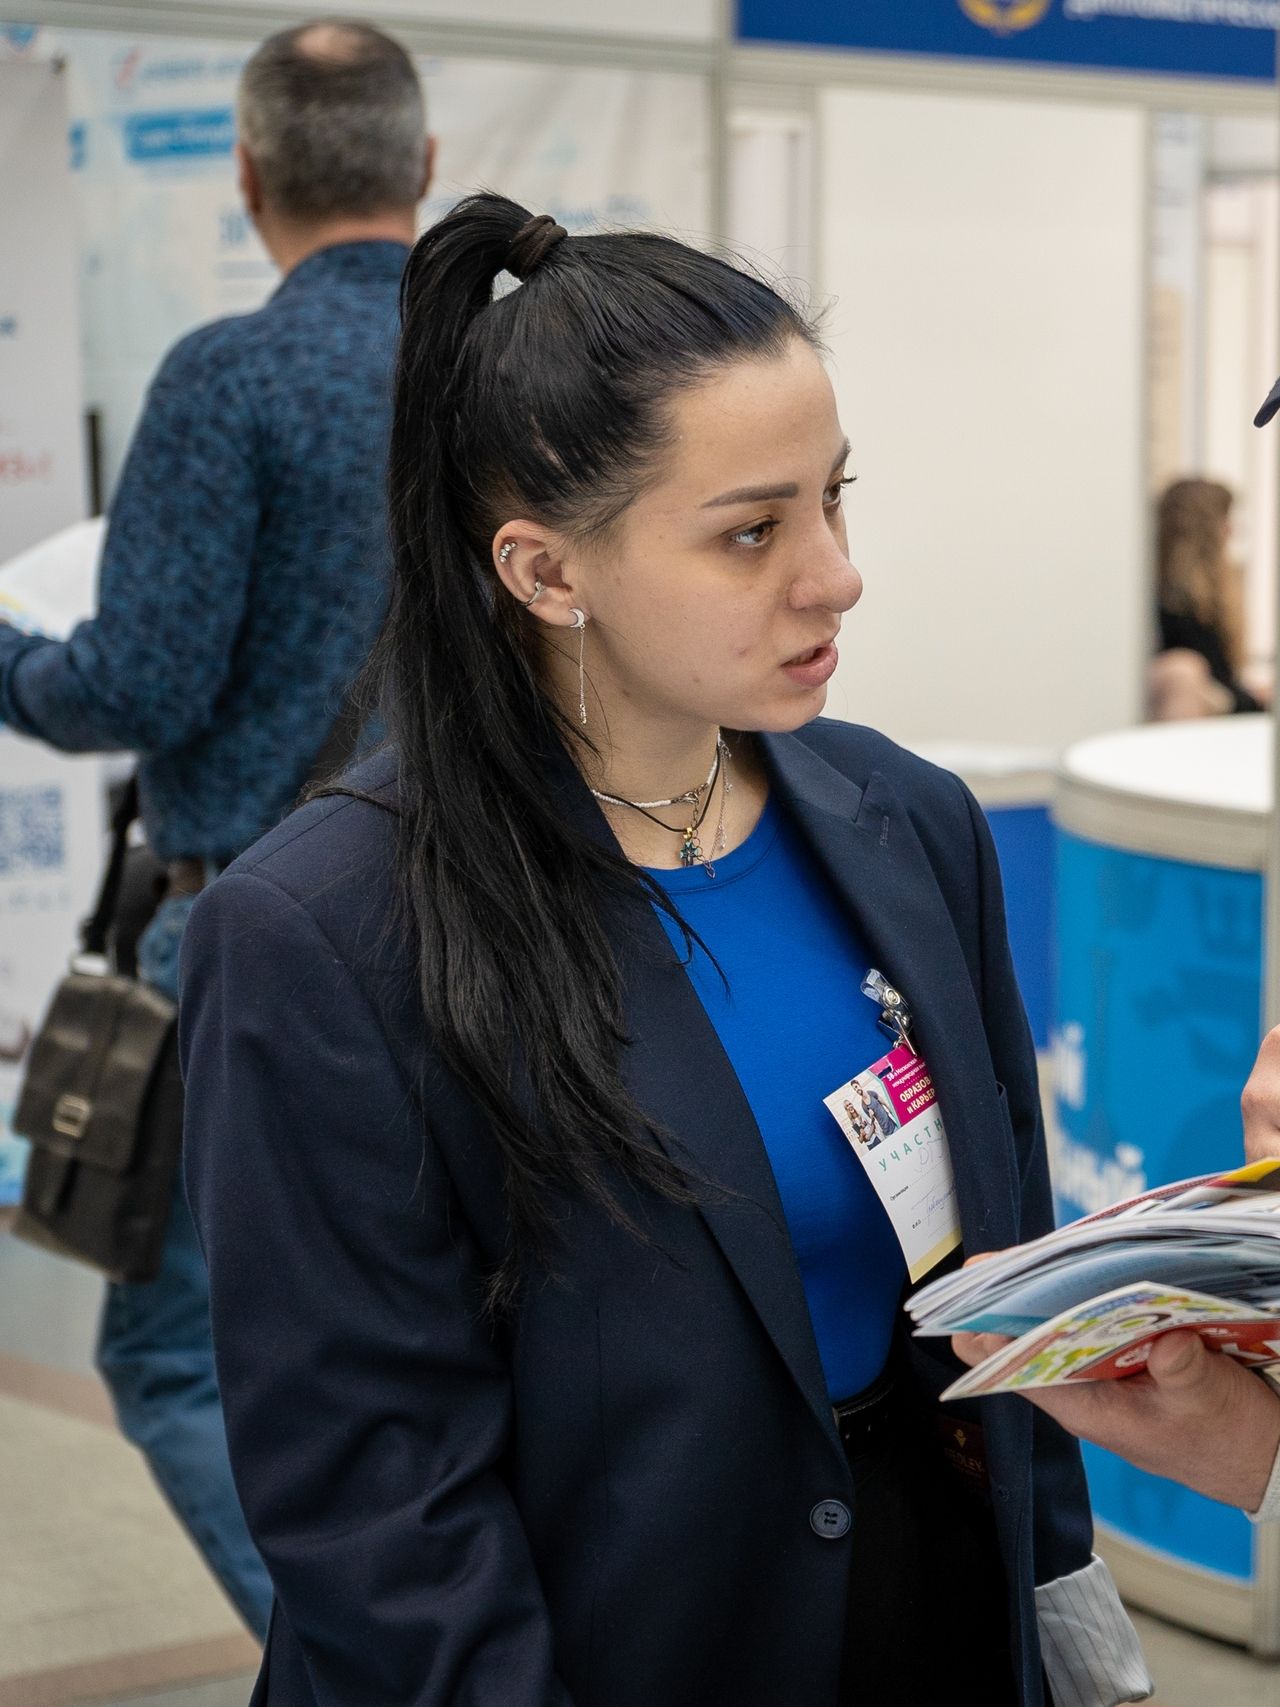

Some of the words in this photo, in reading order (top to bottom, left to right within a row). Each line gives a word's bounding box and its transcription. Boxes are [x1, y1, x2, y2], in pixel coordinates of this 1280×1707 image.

[899, 1075, 932, 1103] ОБРАЗОВ
[910, 1087, 936, 1112] КАРЬЕР
[878, 1117, 943, 1171] УЧАСТН
